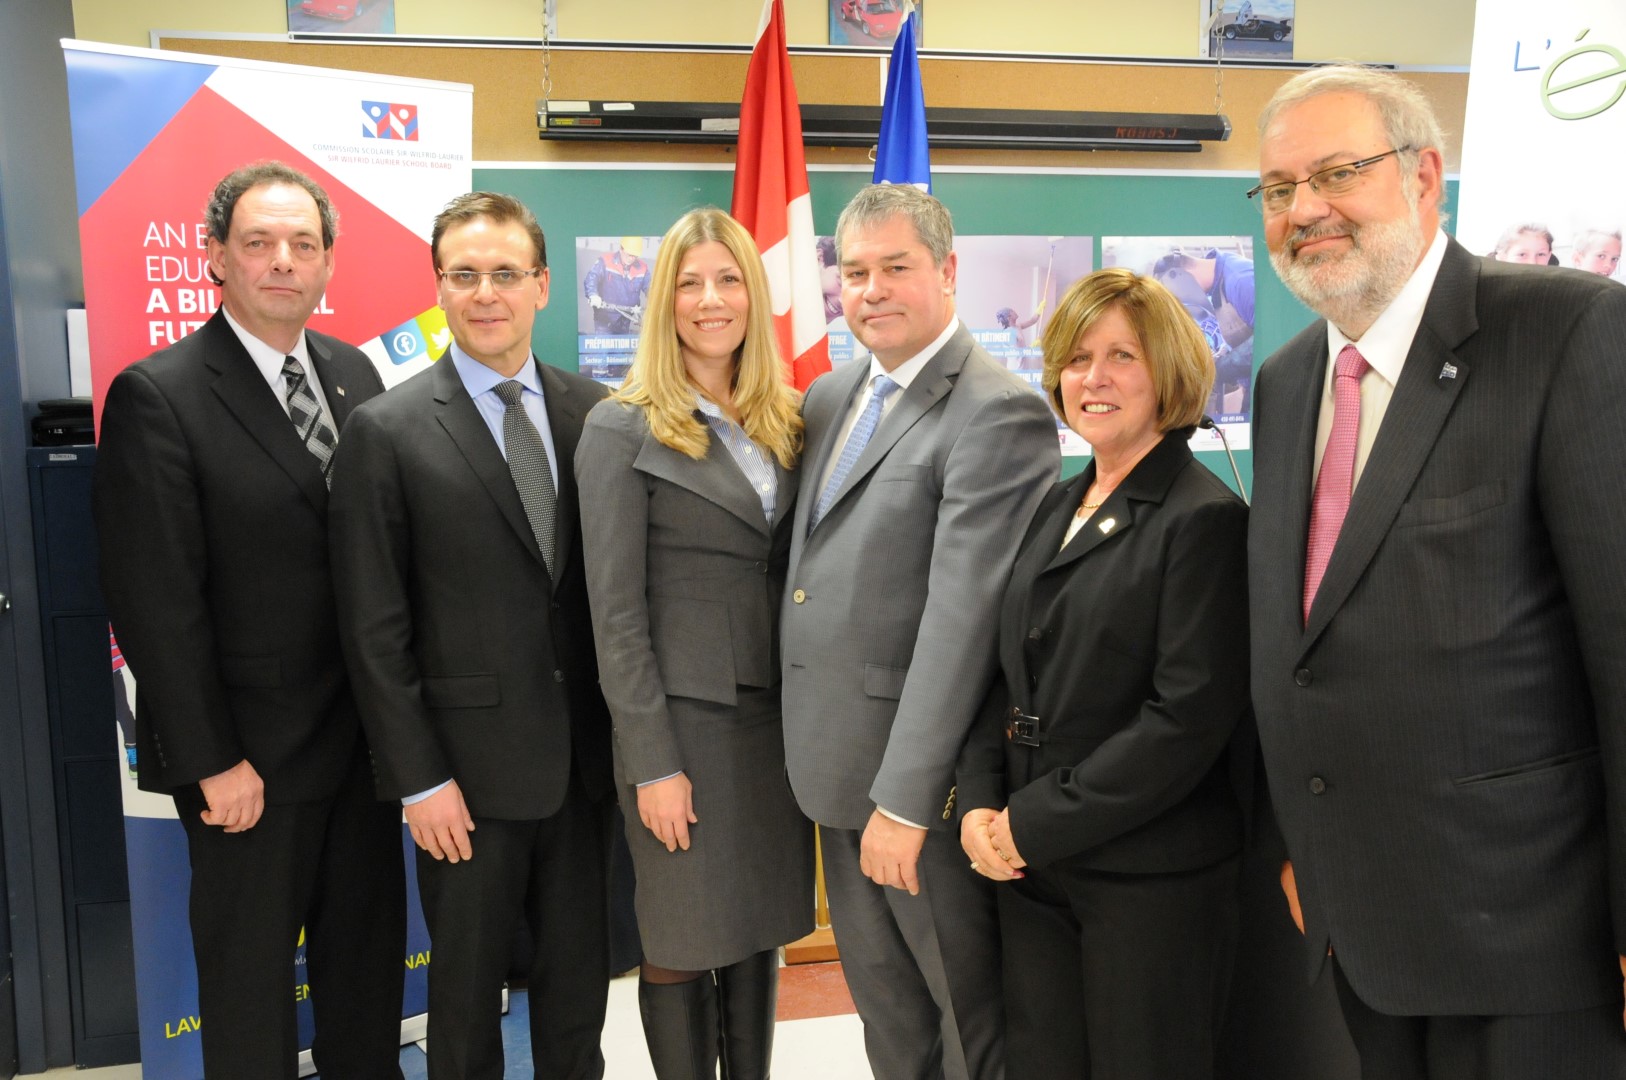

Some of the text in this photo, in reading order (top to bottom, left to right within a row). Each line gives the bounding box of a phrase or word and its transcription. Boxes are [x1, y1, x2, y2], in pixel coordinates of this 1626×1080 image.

[313, 144, 360, 154] COMMISSION
[362, 147, 394, 156] SCOLAIRE
[327, 155, 452, 170] SIR WILFRID LAURIER SCHOOL BOARD
[143, 221, 187, 249] AN
[145, 288, 171, 314] A
[149, 321, 207, 346] FUT
[165, 1015, 201, 1039] LAV
